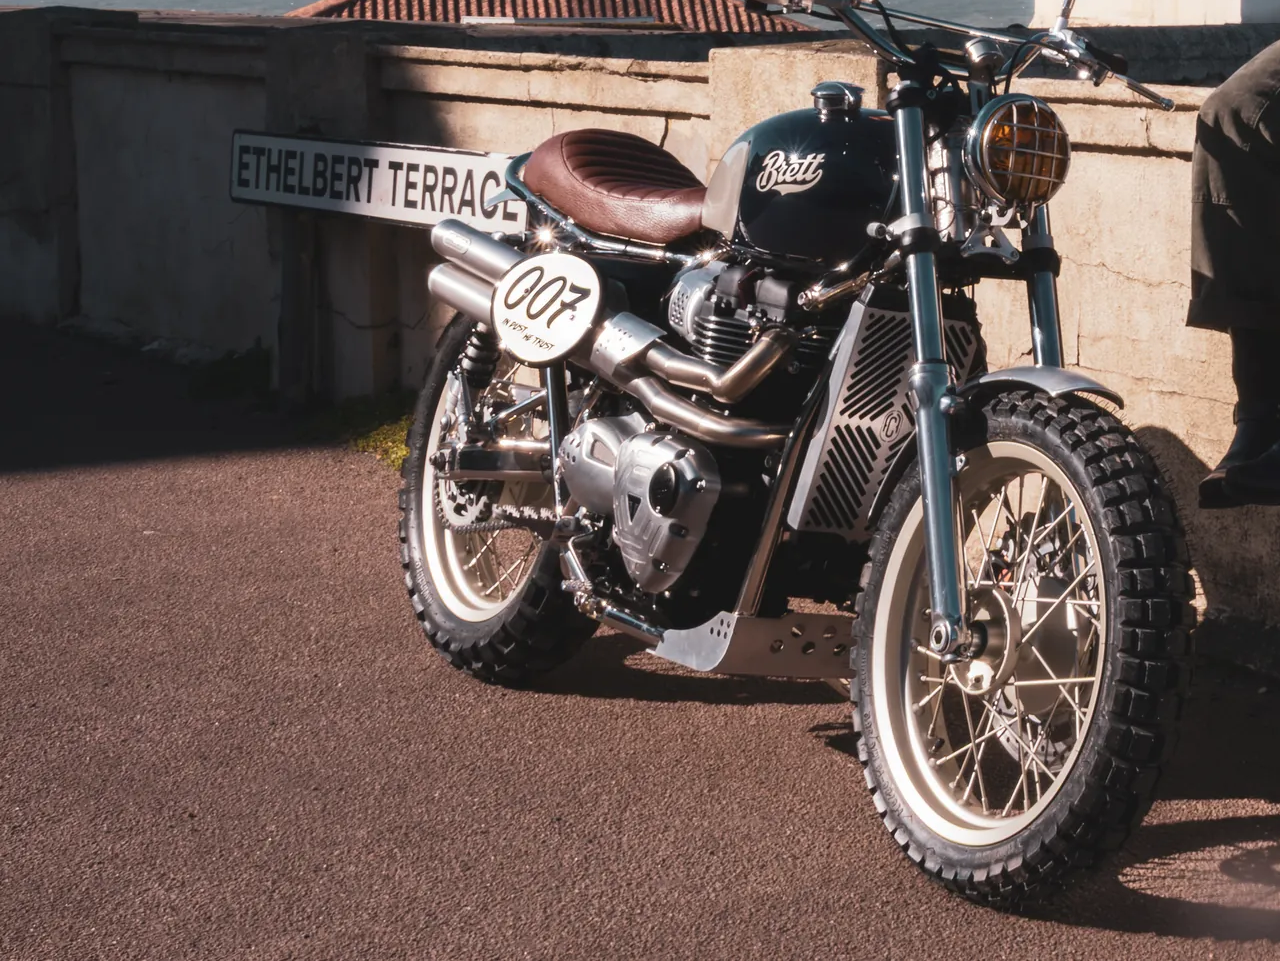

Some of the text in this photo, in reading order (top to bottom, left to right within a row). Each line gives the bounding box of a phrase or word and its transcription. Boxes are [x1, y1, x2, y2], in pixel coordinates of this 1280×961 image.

[237, 145, 379, 204] ETHELBERT
[756, 150, 826, 194] Brett
[504, 266, 592, 329] 007
[532, 337, 555, 351] TRUST
